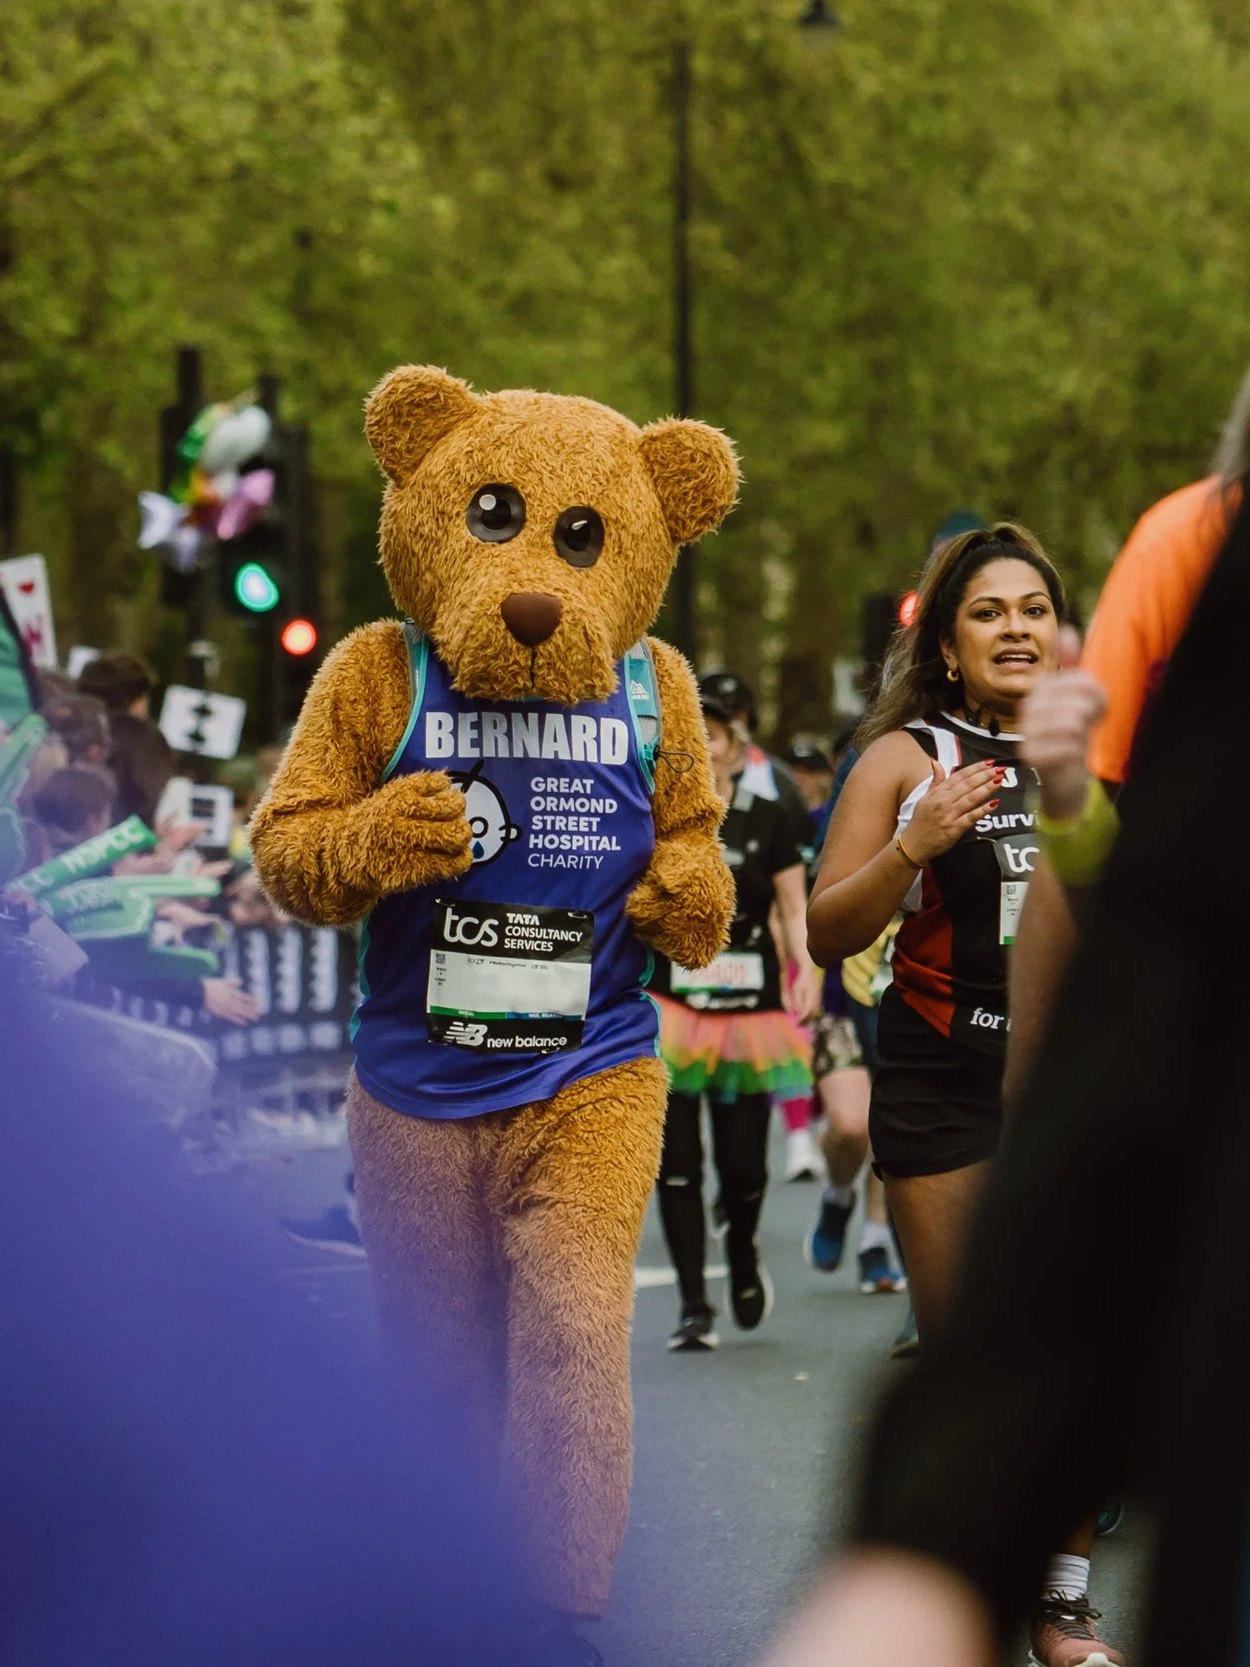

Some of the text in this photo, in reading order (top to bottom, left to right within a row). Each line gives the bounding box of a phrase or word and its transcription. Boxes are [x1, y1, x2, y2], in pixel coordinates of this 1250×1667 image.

[425, 711, 628, 765] BERNARD
[530, 777, 594, 794] GREAT
[530, 796, 618, 814] ORMOND
[531, 815, 600, 832] STREET
[529, 834, 621, 851] HOSPITAL
[528, 854, 604, 870] CHARITY
[443, 907, 500, 947] tcs
[506, 913, 540, 926] TATA
[505, 926, 583, 942] CONSULTANCY
[504, 938, 553, 952] SERVICES
[970, 1007, 1004, 1029] for
[487, 1035, 567, 1048] new balance
